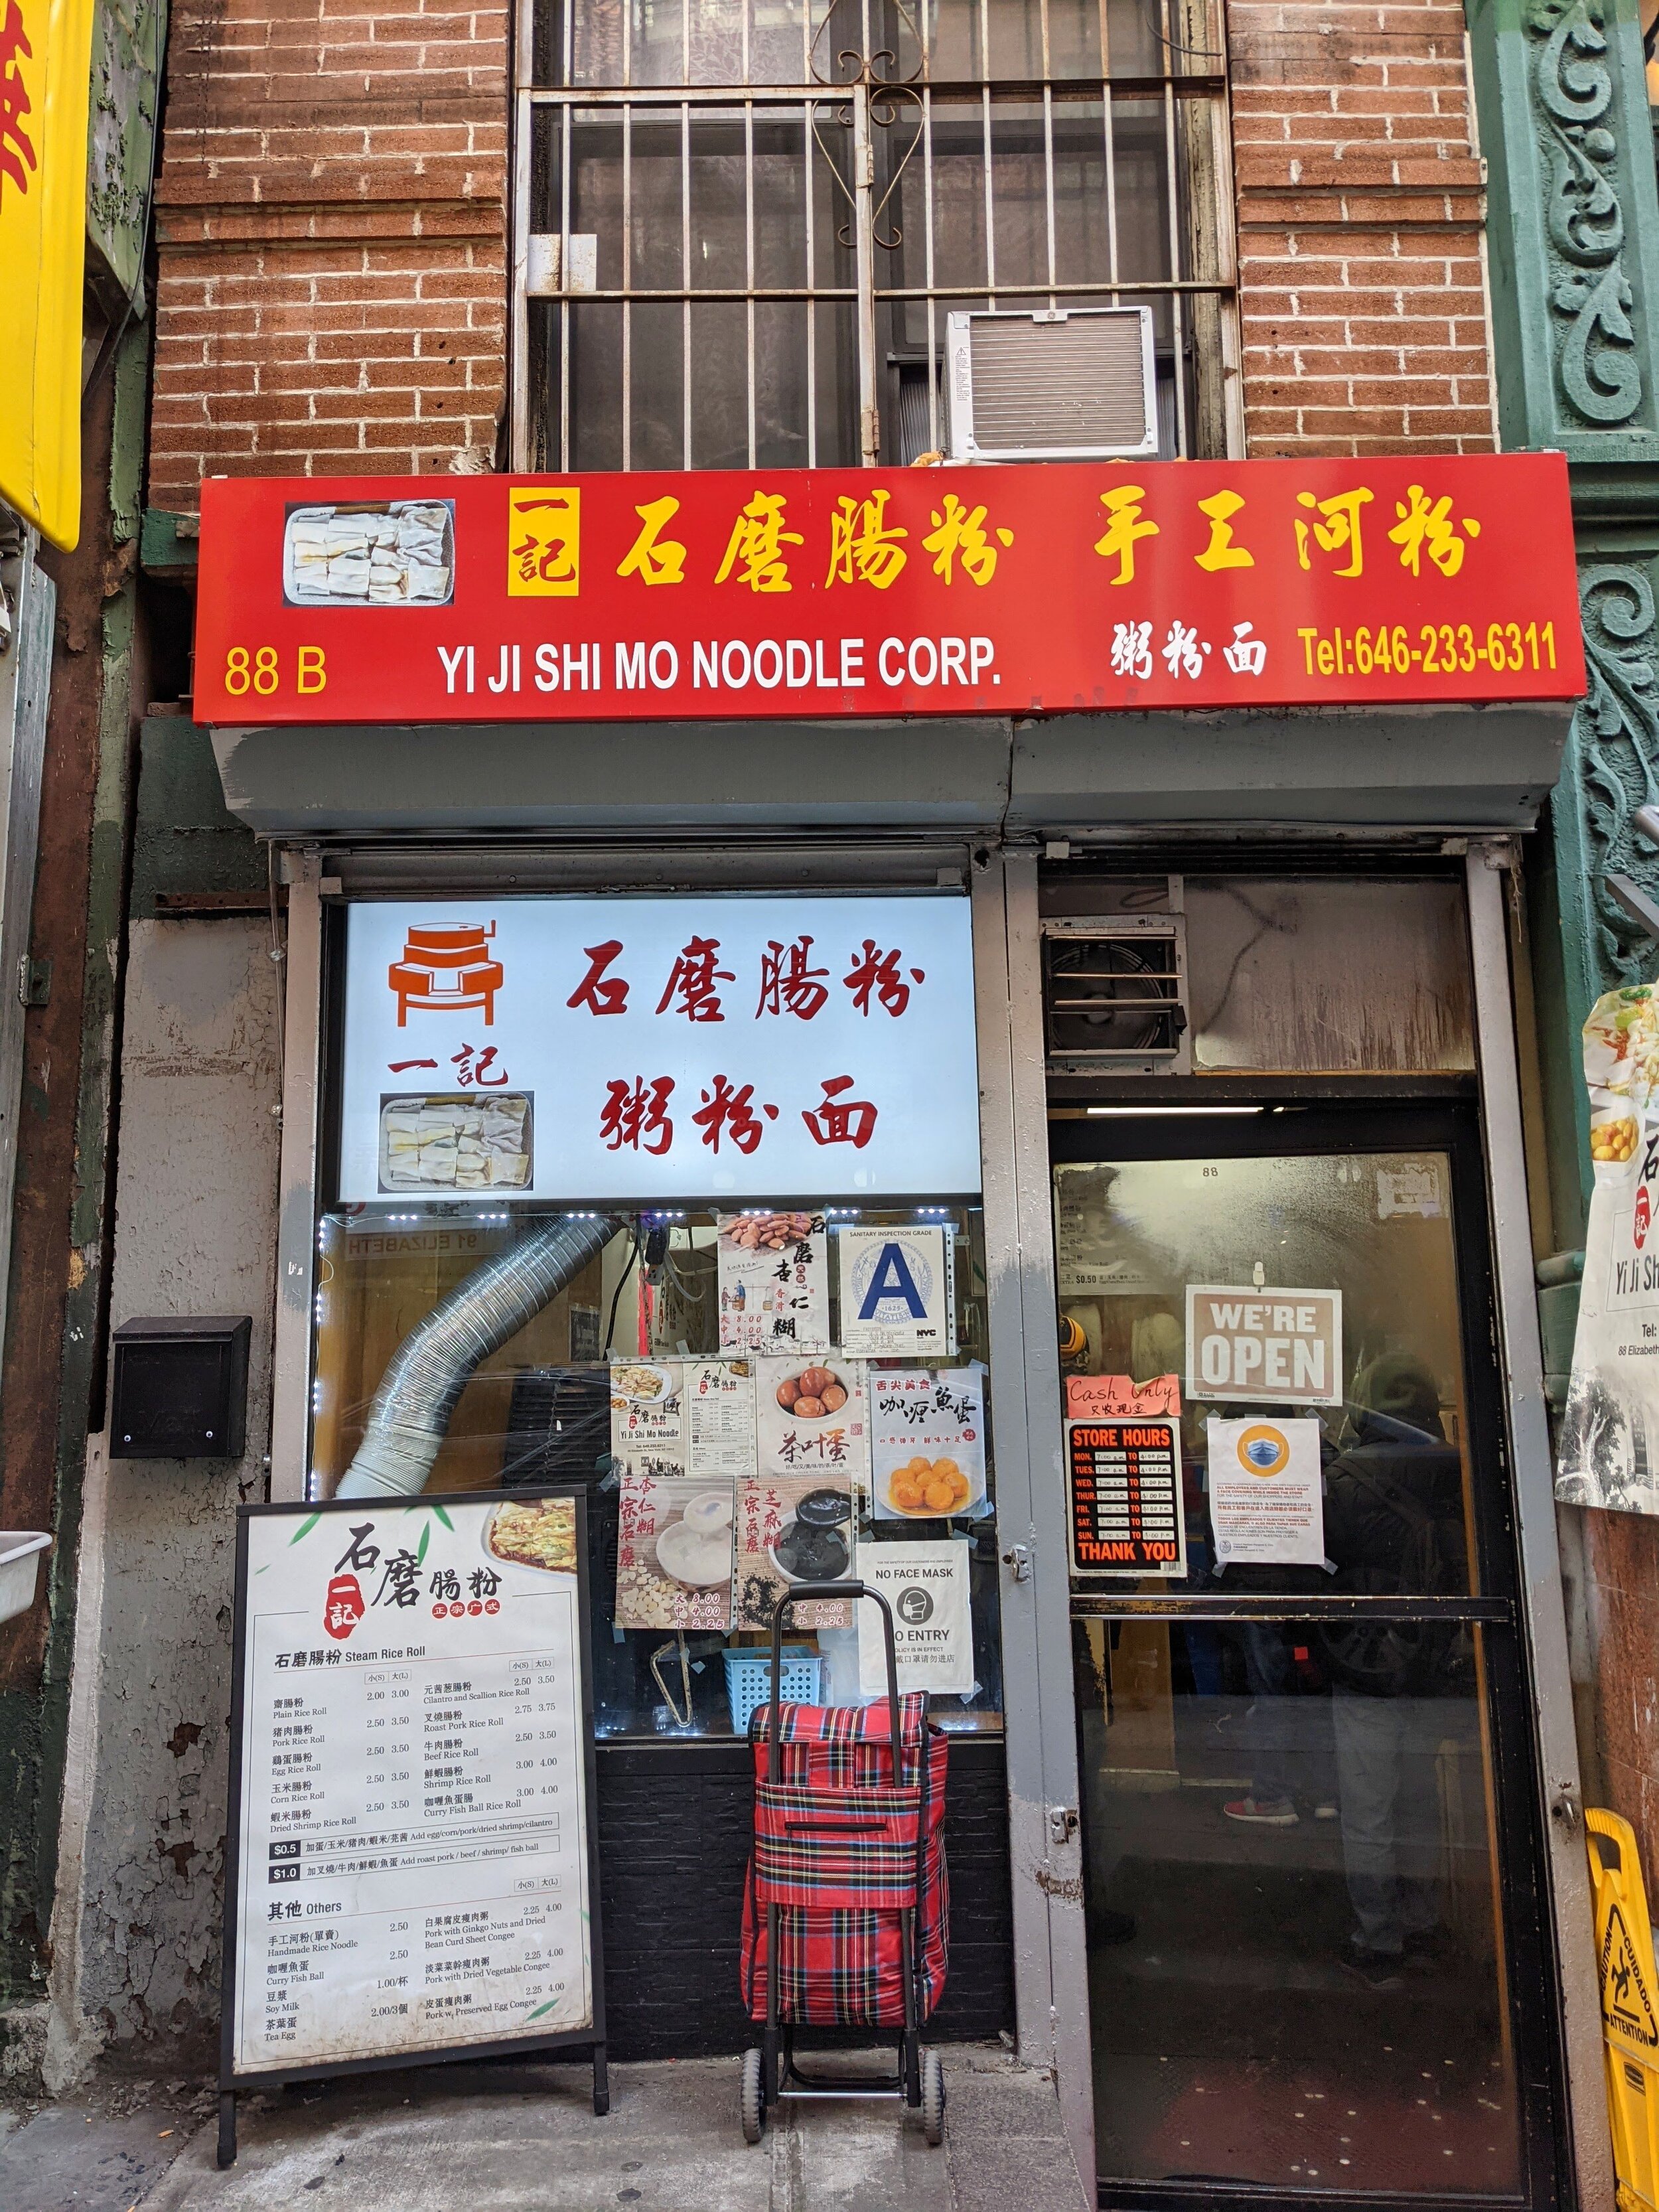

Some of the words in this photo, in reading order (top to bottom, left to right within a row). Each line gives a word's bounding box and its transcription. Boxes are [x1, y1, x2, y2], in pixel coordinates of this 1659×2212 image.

[514, 497, 576, 583] 一記
[617, 488, 1014, 593] 石磨腸粉
[1094, 485, 1480, 585] 手工河粉
[1111, 620, 1266, 679] 粥粉面
[1297, 621, 1557, 676] Tel:646-233-6311
[225, 647, 279, 695] 88
[297, 646, 327, 694] B
[437, 646, 474, 694] YI
[489, 645, 521, 692] JI
[536, 643, 601, 692] SHI
[614, 640, 678, 690] MO
[693, 638, 864, 689] NOODLE
[878, 636, 1001, 686] CORP.
[567, 935, 924, 1022] 石磨腸粉
[388, 1043, 508, 1087] 一記
[599, 1074, 877, 1155] 粥粉面
[1202, 1167, 1218, 1177] 88
[857, 1243, 928, 1319] A
[1076, 1275, 1097, 1284] $0.50
[1617, 1261, 1627, 1295] Yi
[1630, 1258, 1639, 1293] Ji
[721, 1315, 730, 1324] 大
[1210, 1302, 1317, 1332] WE'RE
[1642, 1323, 1657, 1337] Tel:
[1619, 1345, 1626, 1356] 88
[1628, 1344, 1659, 1355] Elizabeth
[1201, 1334, 1325, 1389] OPEN
[877, 1379, 930, 1391] 舌尖美食
[1070, 1380, 1119, 1400] Cash
[1091, 1402, 1147, 1416] 只收现金
[1074, 1429, 1118, 1446] STORE
[1123, 1428, 1170, 1446] HOURS
[1078, 1542, 1136, 1560] THANK
[1142, 1542, 1175, 1560] YOU
[334, 1522, 502, 1609] 石磨腸粉
[876, 1570, 891, 1579] NO
[895, 1569, 919, 1578] FACE
[922, 1568, 953, 1578] MASK
[675, 1593, 686, 1604] 大
[692, 1593, 721, 1603] 8.00
[675, 1606, 685, 1617] 中
[691, 1606, 721, 1617] 4.00
[674, 1619, 685, 1629] 小
[692, 1619, 725, 1629] 2.25
[816, 1617, 843, 1626] 2.25
[908, 1630, 950, 1641] ENTRY
[275, 1649, 342, 1668] 石磨腸粉
[346, 1651, 378, 1662] Steam
[382, 1649, 403, 1659] Rice
[406, 1646, 425, 1657] Roll
[514, 1677, 531, 1686] 2.50
[538, 1675, 555, 1684] 3.50
[367, 1692, 384, 1700] 2.00
[392, 1690, 409, 1698] 3.00
[424, 1695, 453, 1704] Cilantro
[469, 1691, 496, 1700] Scallion
[367, 1746, 384, 1755] 2.50
[392, 1744, 409, 1753] 3.50
[272, 1767, 285, 1777] Egg
[424, 1766, 463, 1779] 鮮蝦腸粉
[272, 1780, 312, 1794] 玉米腸粉
[274, 1844, 296, 1856] $0.5
[427, 1825, 497, 1840] egg/corn/pork/dried
[499, 1820, 552, 1830] shrimp/cilantro
[273, 1868, 297, 1880] $1.0
[267, 1900, 302, 1921] 其他
[307, 1902, 342, 1915] Others
[267, 1947, 310, 1957] Handmade
[330, 1940, 358, 1950] Noodle
[1623, 1935, 1651, 2014] CUIDADO
[265, 2017, 297, 2031] 茶葉蛋
[1609, 2013, 1649, 2047] ATTENTION
